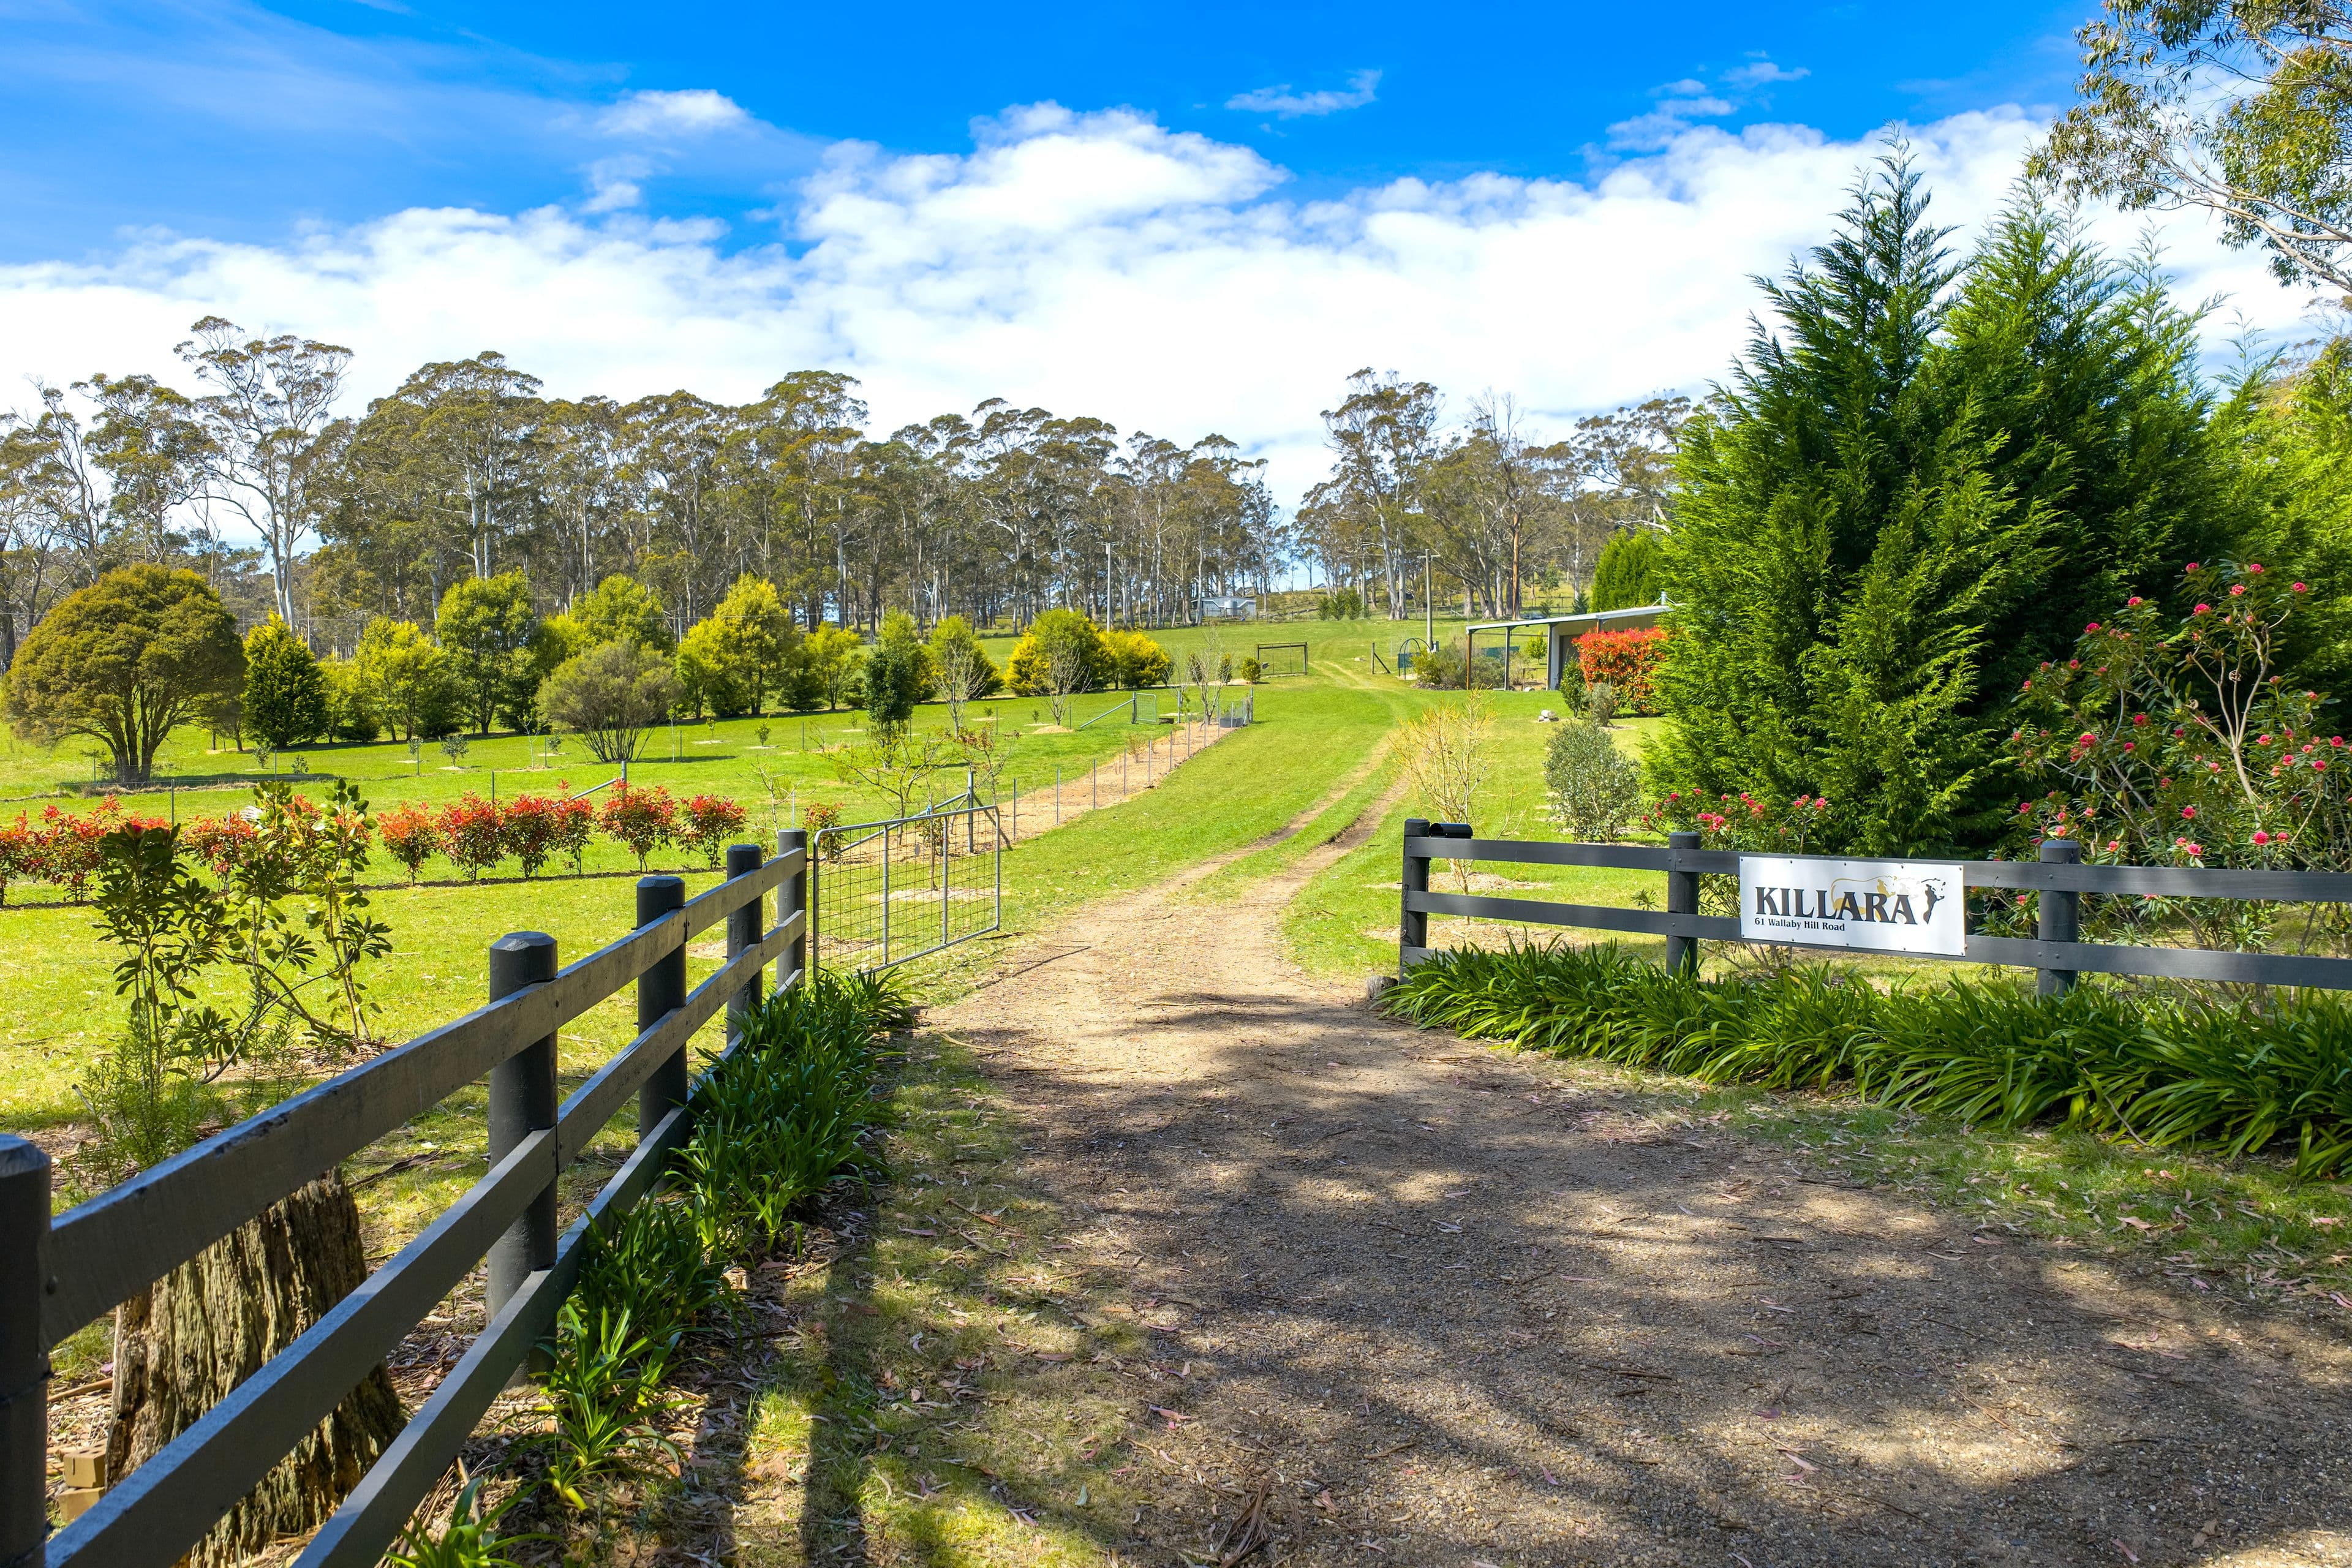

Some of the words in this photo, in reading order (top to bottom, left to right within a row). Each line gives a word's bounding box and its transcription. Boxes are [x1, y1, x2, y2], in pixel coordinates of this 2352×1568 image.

[1755, 886, 1918, 925] KILLARA
[1754, 917, 1765, 925] 61
[1768, 918, 1801, 930] Wallaby
[1804, 921, 1819, 929] Hill
[1822, 922, 1845, 931] Road
